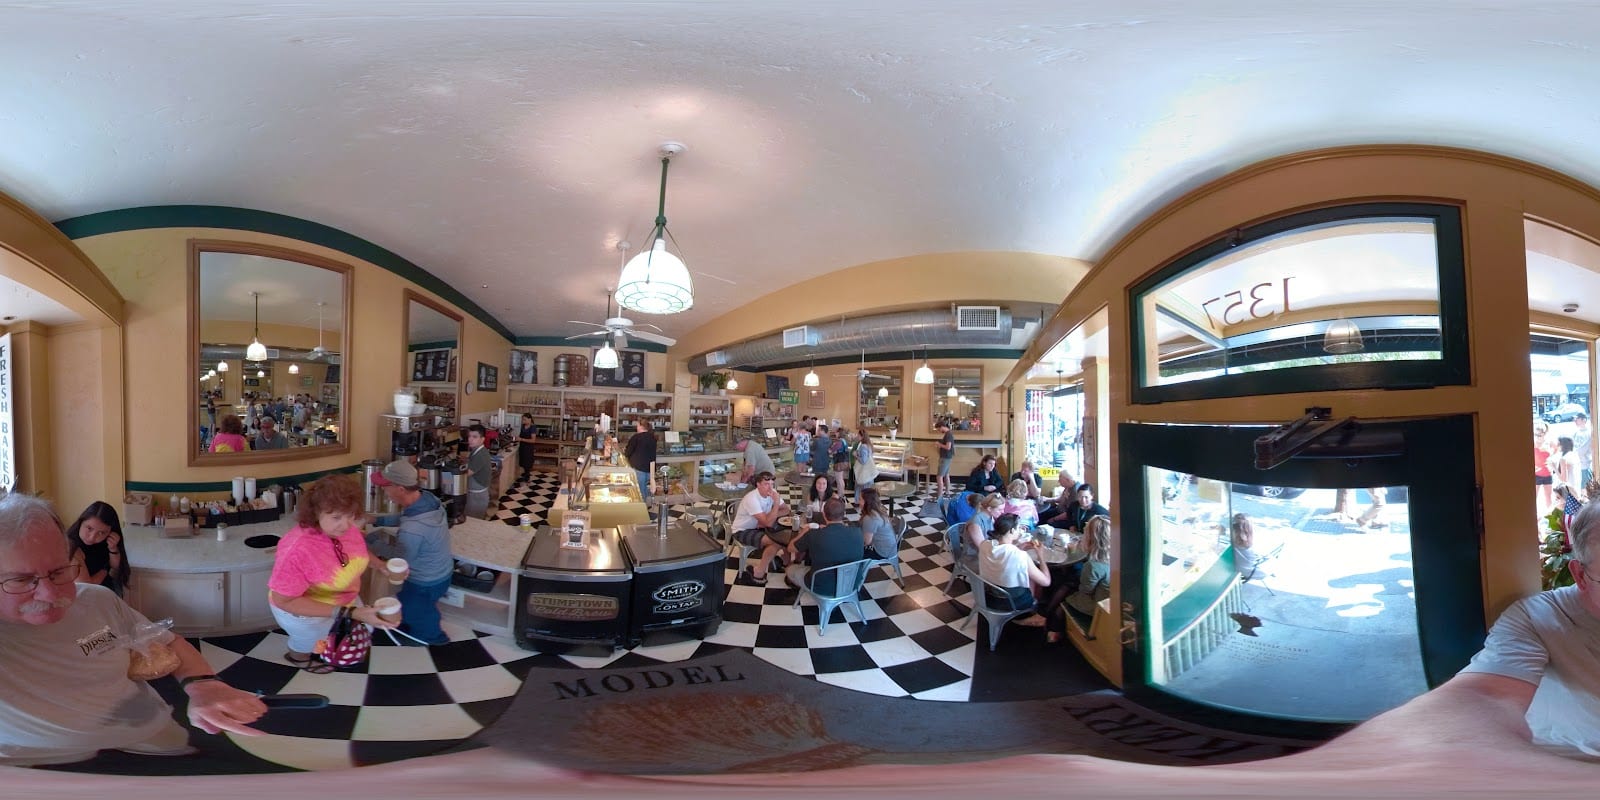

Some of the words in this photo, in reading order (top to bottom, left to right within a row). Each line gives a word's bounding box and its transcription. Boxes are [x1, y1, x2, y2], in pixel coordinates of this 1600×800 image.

[0, 345, 8, 413] FRESH
[2, 422, 10, 485] BAKED
[534, 596, 613, 608] STUMPTOWN
[661, 585, 698, 598] SMITH
[663, 603, 678, 611] ON
[679, 600, 695, 608] TAP
[552, 664, 746, 700] MODEL
